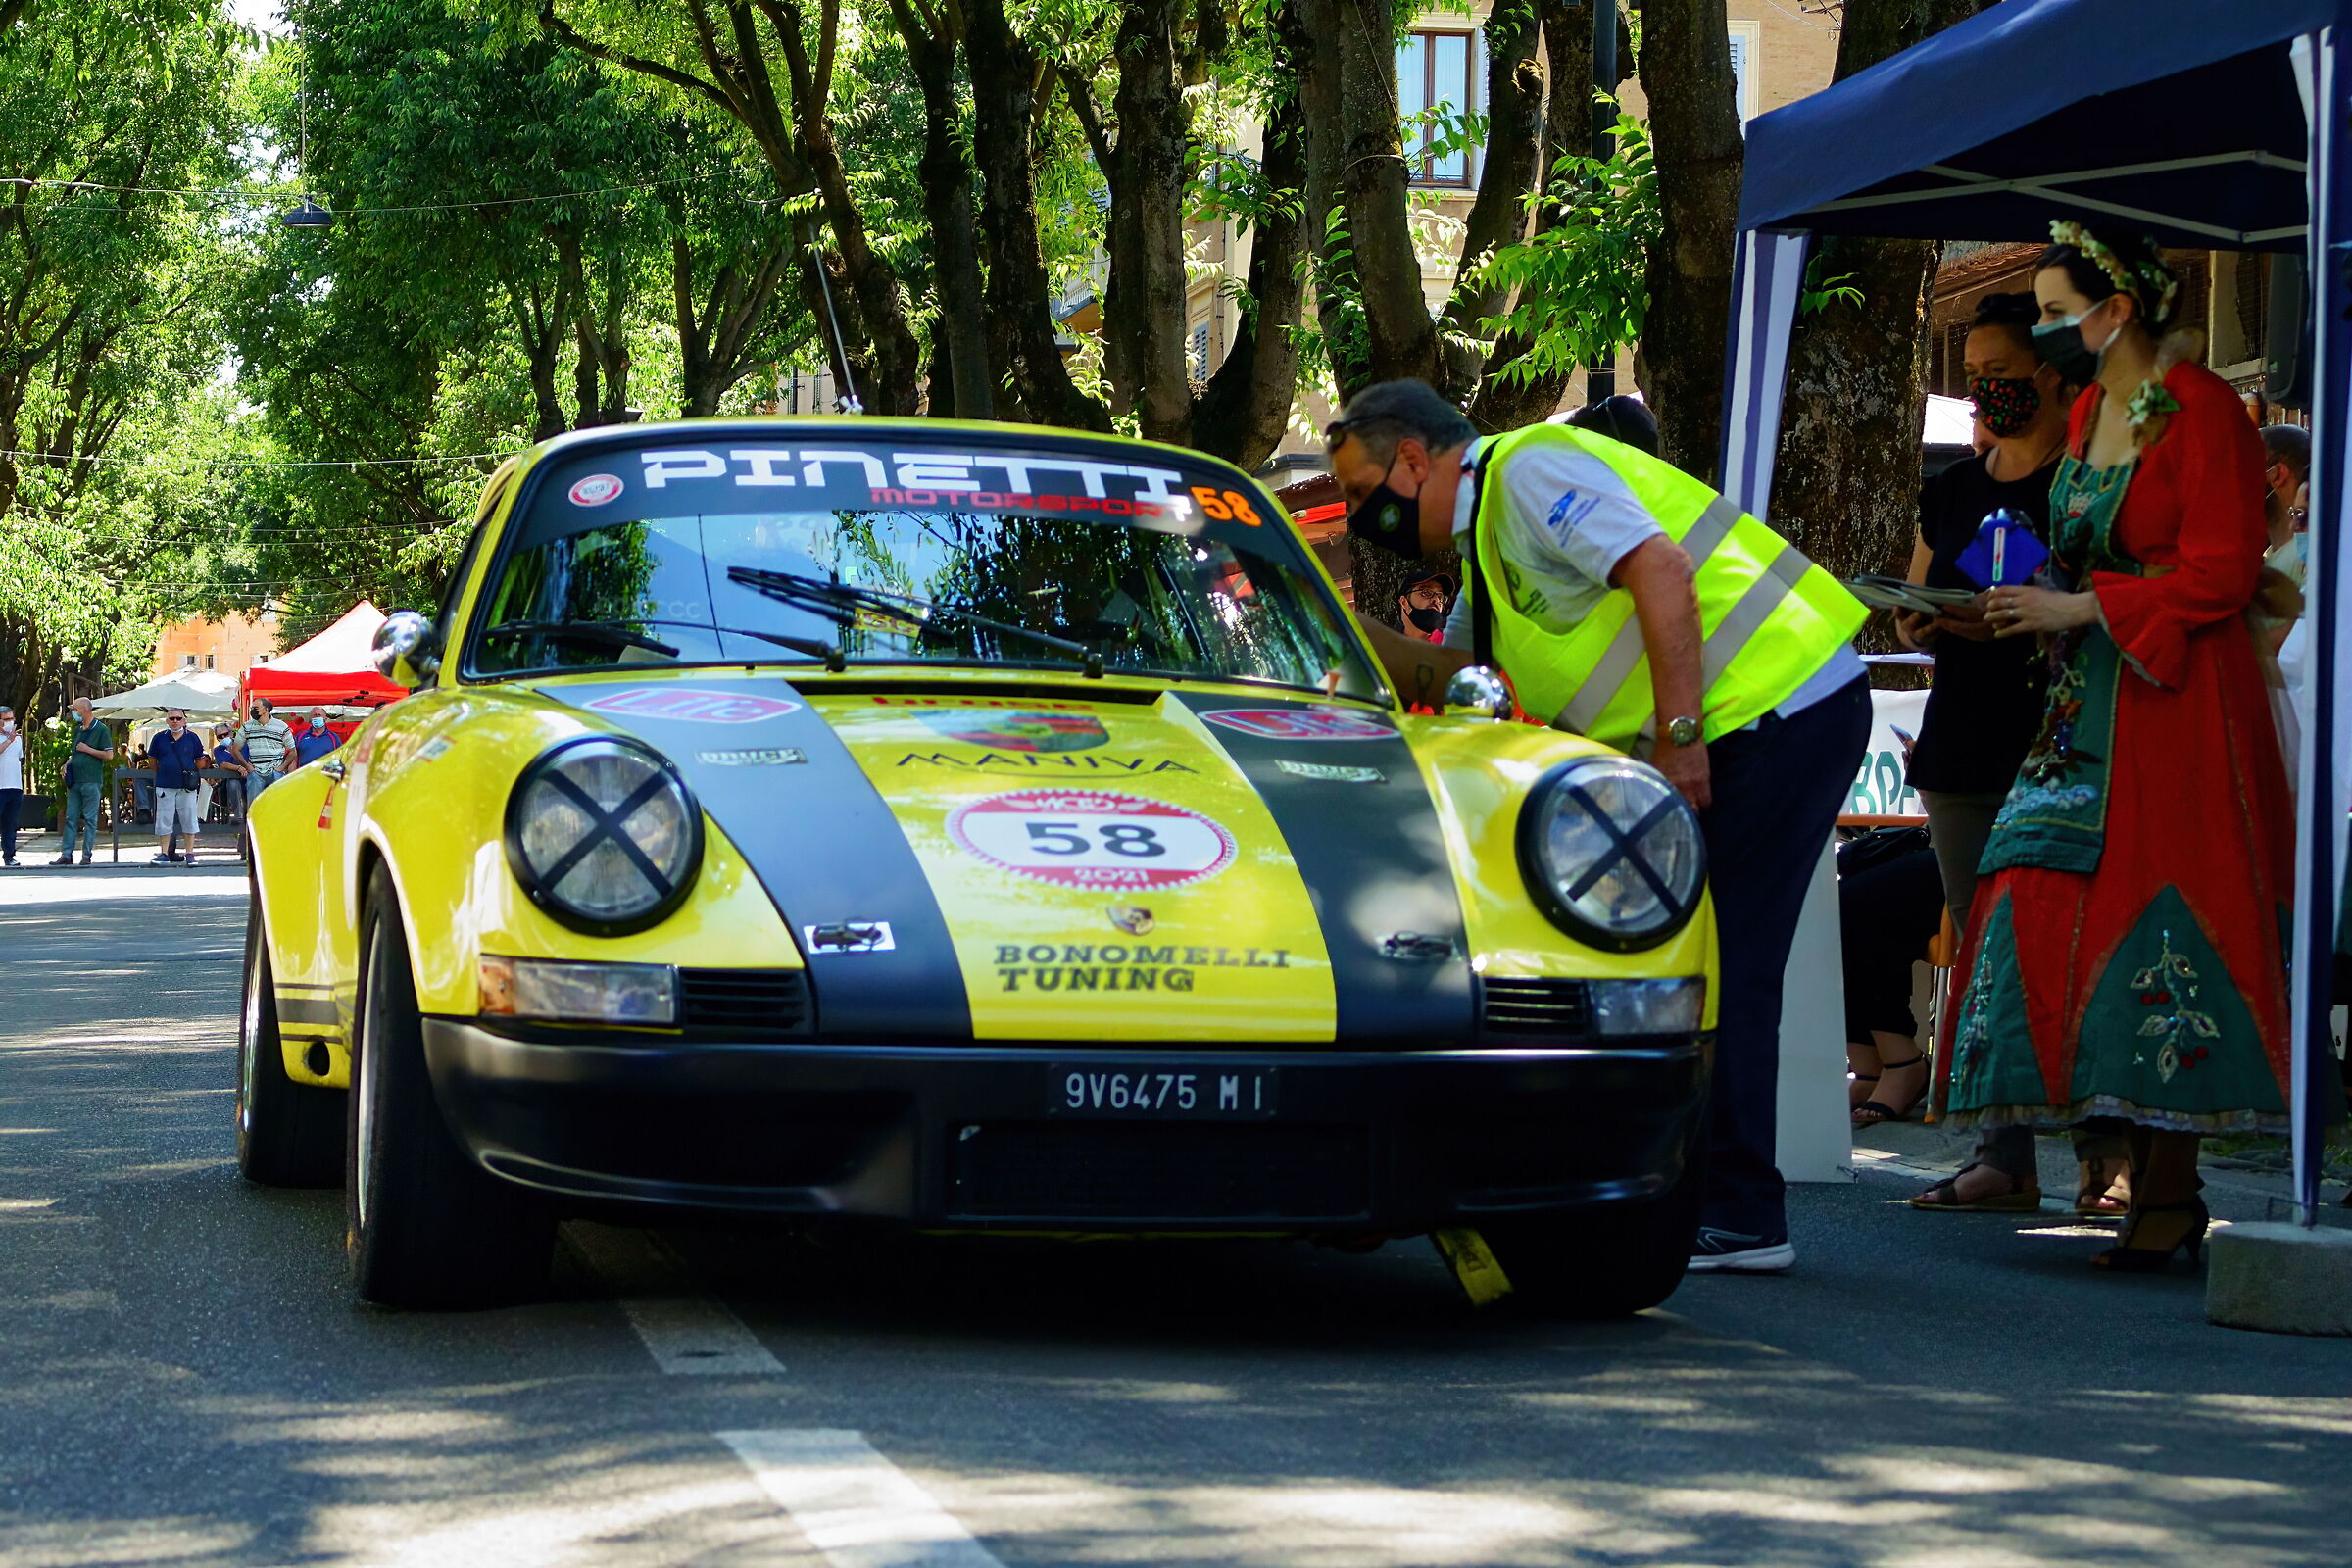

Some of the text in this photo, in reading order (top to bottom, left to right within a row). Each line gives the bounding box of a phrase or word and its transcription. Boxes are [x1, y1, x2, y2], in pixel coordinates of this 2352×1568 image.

[641, 449, 1189, 508] PINETTI
[1190, 486, 1262, 527] 58
[896, 753, 1200, 775] MANIVA
[1025, 822, 1166, 858] 58
[994, 944, 1291, 968] BONOMELLI
[997, 967, 1195, 992] TUNING
[1066, 1073, 1197, 1109] 9V6475
